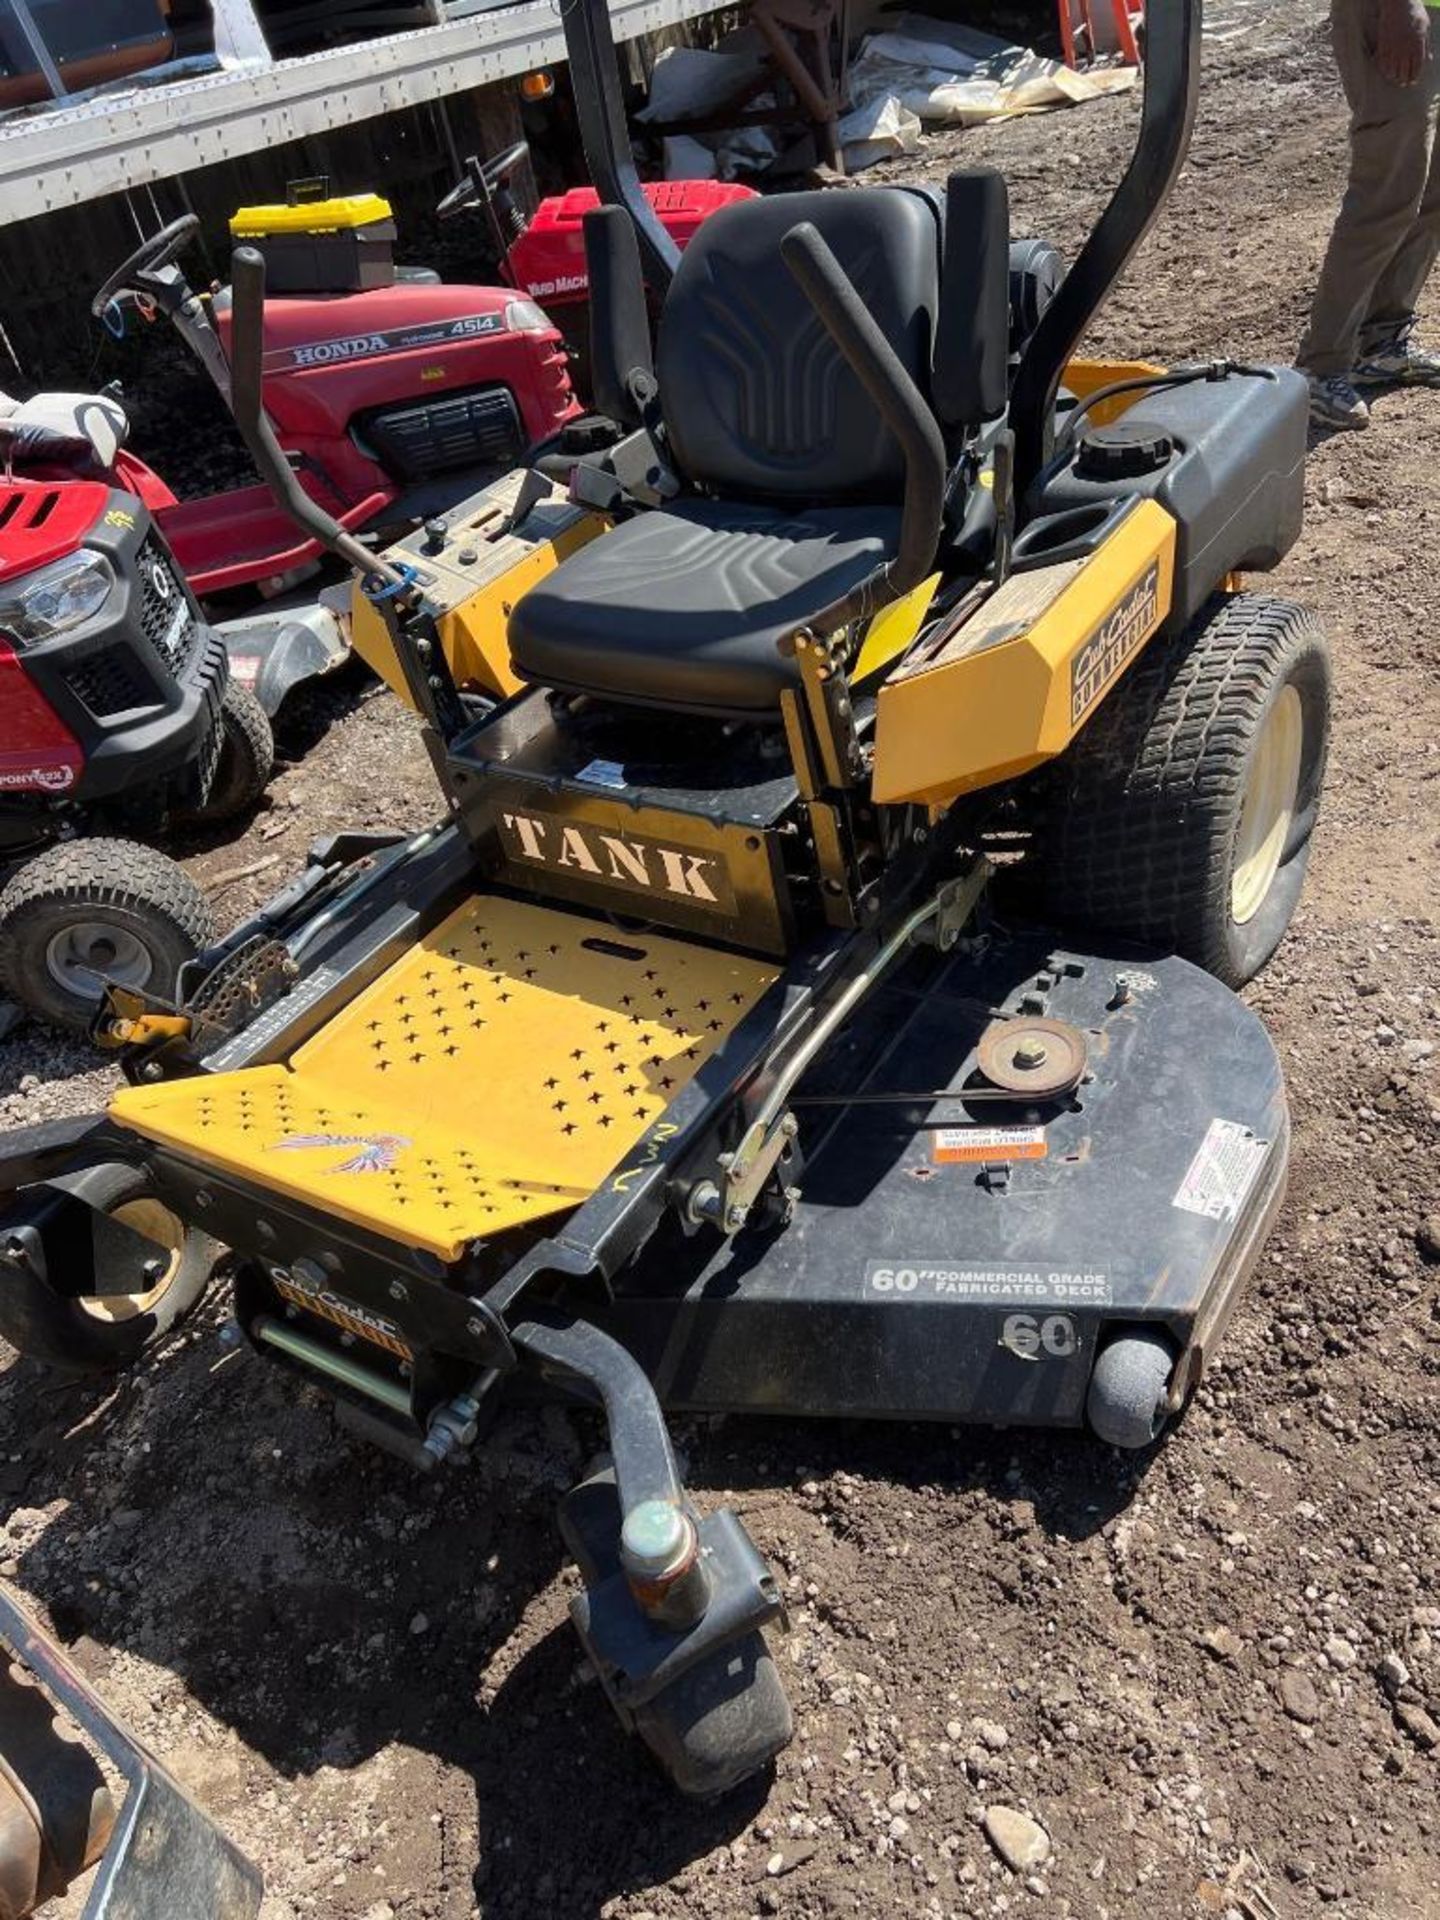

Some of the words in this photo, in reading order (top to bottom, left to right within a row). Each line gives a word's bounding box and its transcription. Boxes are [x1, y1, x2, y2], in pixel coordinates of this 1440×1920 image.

[527, 281, 555, 297] YARD
[293, 335, 389, 364] HONDA
[450, 316, 495, 335] 4514
[1074, 628, 1107, 687] Cub
[1107, 569, 1157, 647] Cadet
[503, 813, 718, 902] TANK
[935, 1281, 1048, 1295] FABRICATED
[1054, 1284, 1107, 1297] DECK
[936, 1271, 1044, 1284] COMMERCIAL
[1048, 1273, 1107, 1285] GRADE
[1003, 1313, 1077, 1357] 60
